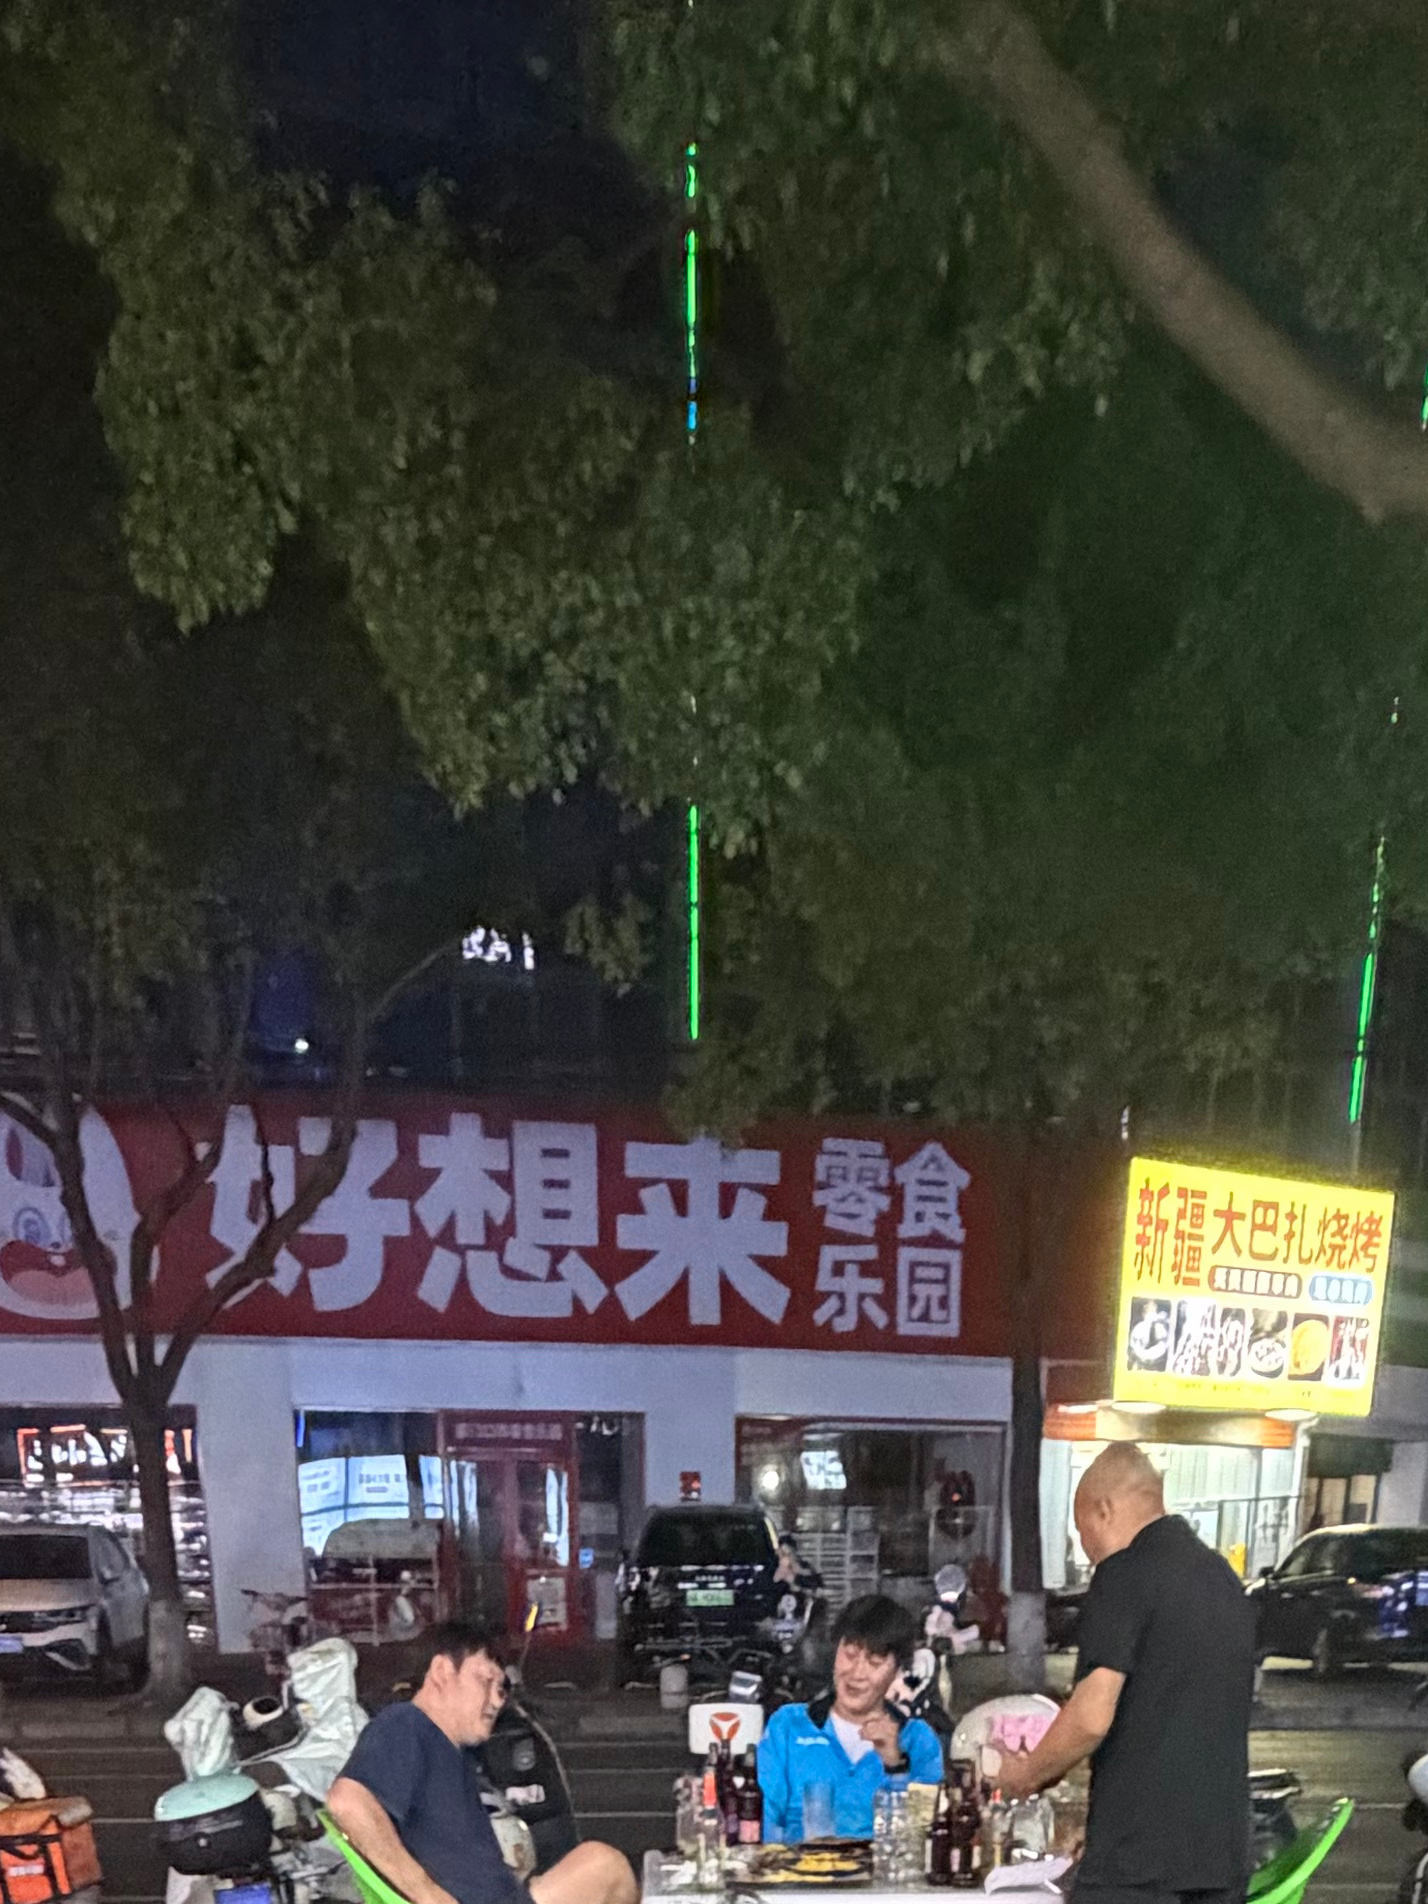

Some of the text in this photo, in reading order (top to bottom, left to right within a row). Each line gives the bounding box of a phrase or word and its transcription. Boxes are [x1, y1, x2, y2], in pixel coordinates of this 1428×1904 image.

[196, 1104, 791, 1326] 好想来
[813, 1137, 971, 1244] 零食
[1134, 1176, 1384, 1288] 新疆大巴扎烧烤
[813, 1245, 963, 1339] 乐园
